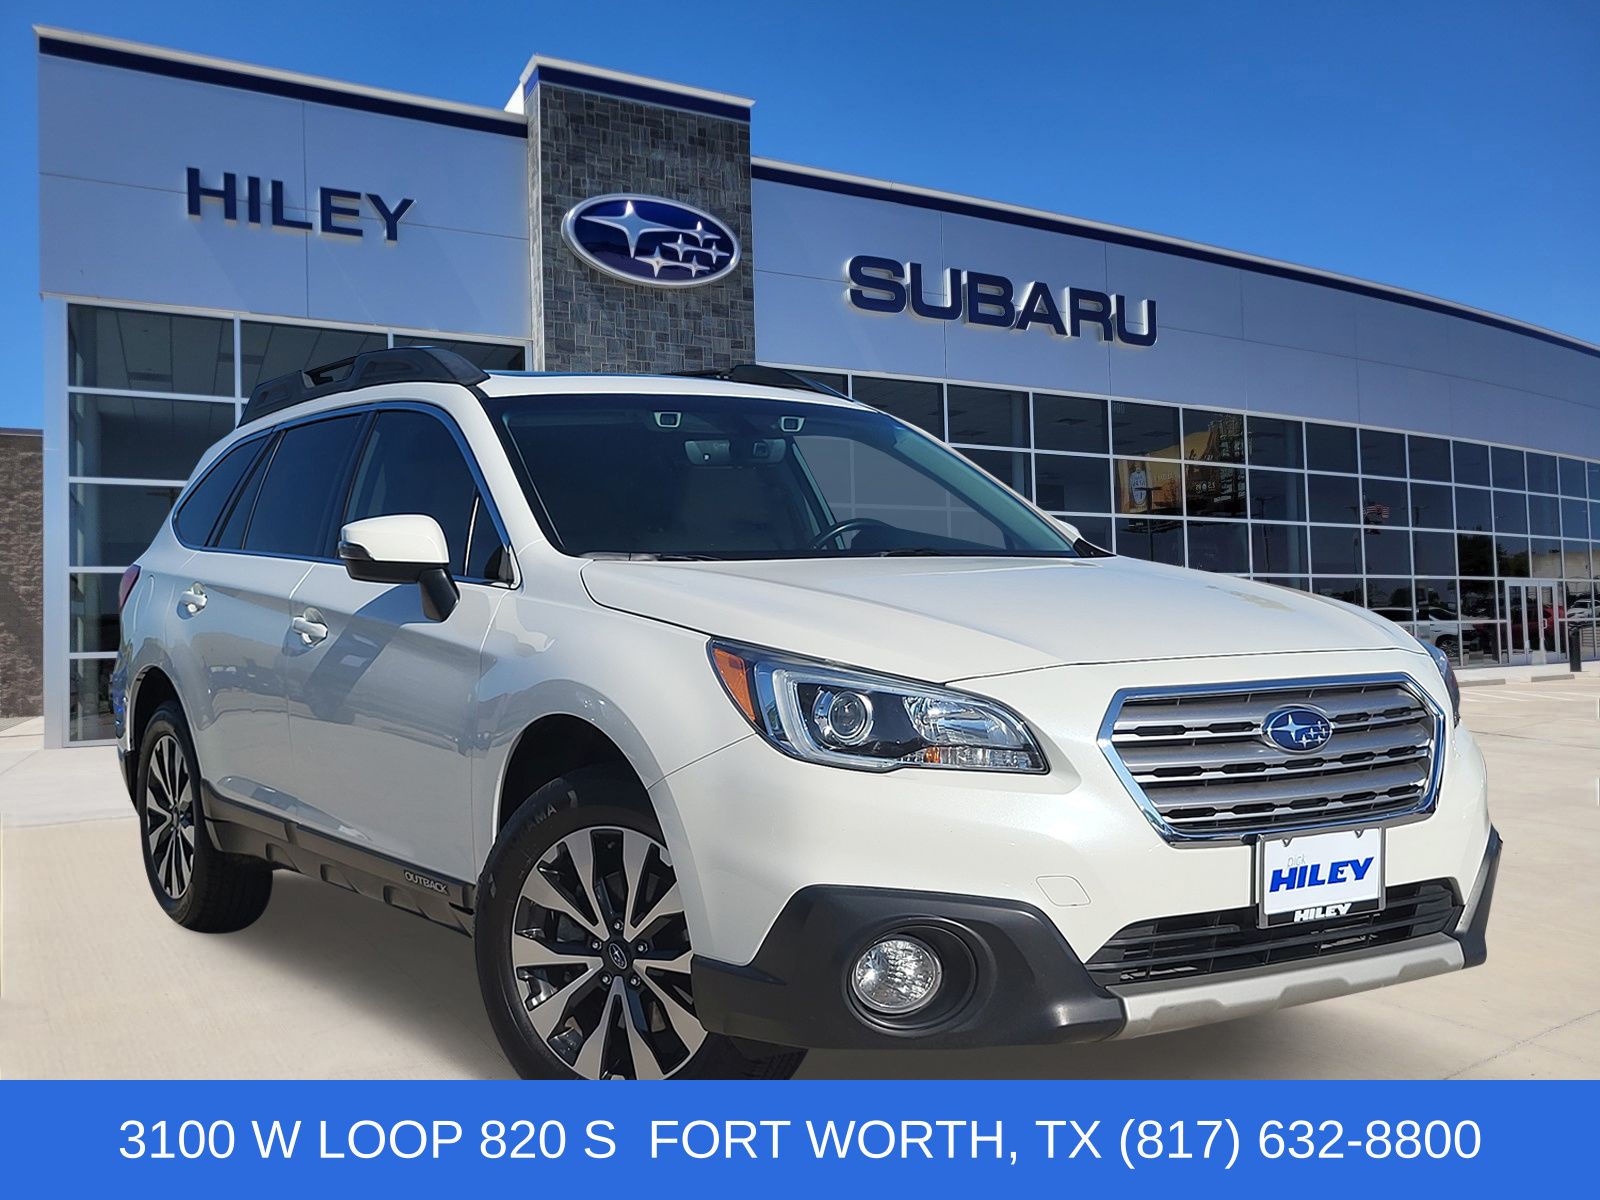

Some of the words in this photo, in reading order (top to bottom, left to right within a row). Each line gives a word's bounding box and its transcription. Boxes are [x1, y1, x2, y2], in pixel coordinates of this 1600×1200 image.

[187, 167, 415, 242] HILEY
[848, 255, 1158, 347] SUBARU
[403, 870, 449, 895] OUTBACK
[1269, 856, 1375, 893] HILEY
[1293, 902, 1352, 923] HILEY
